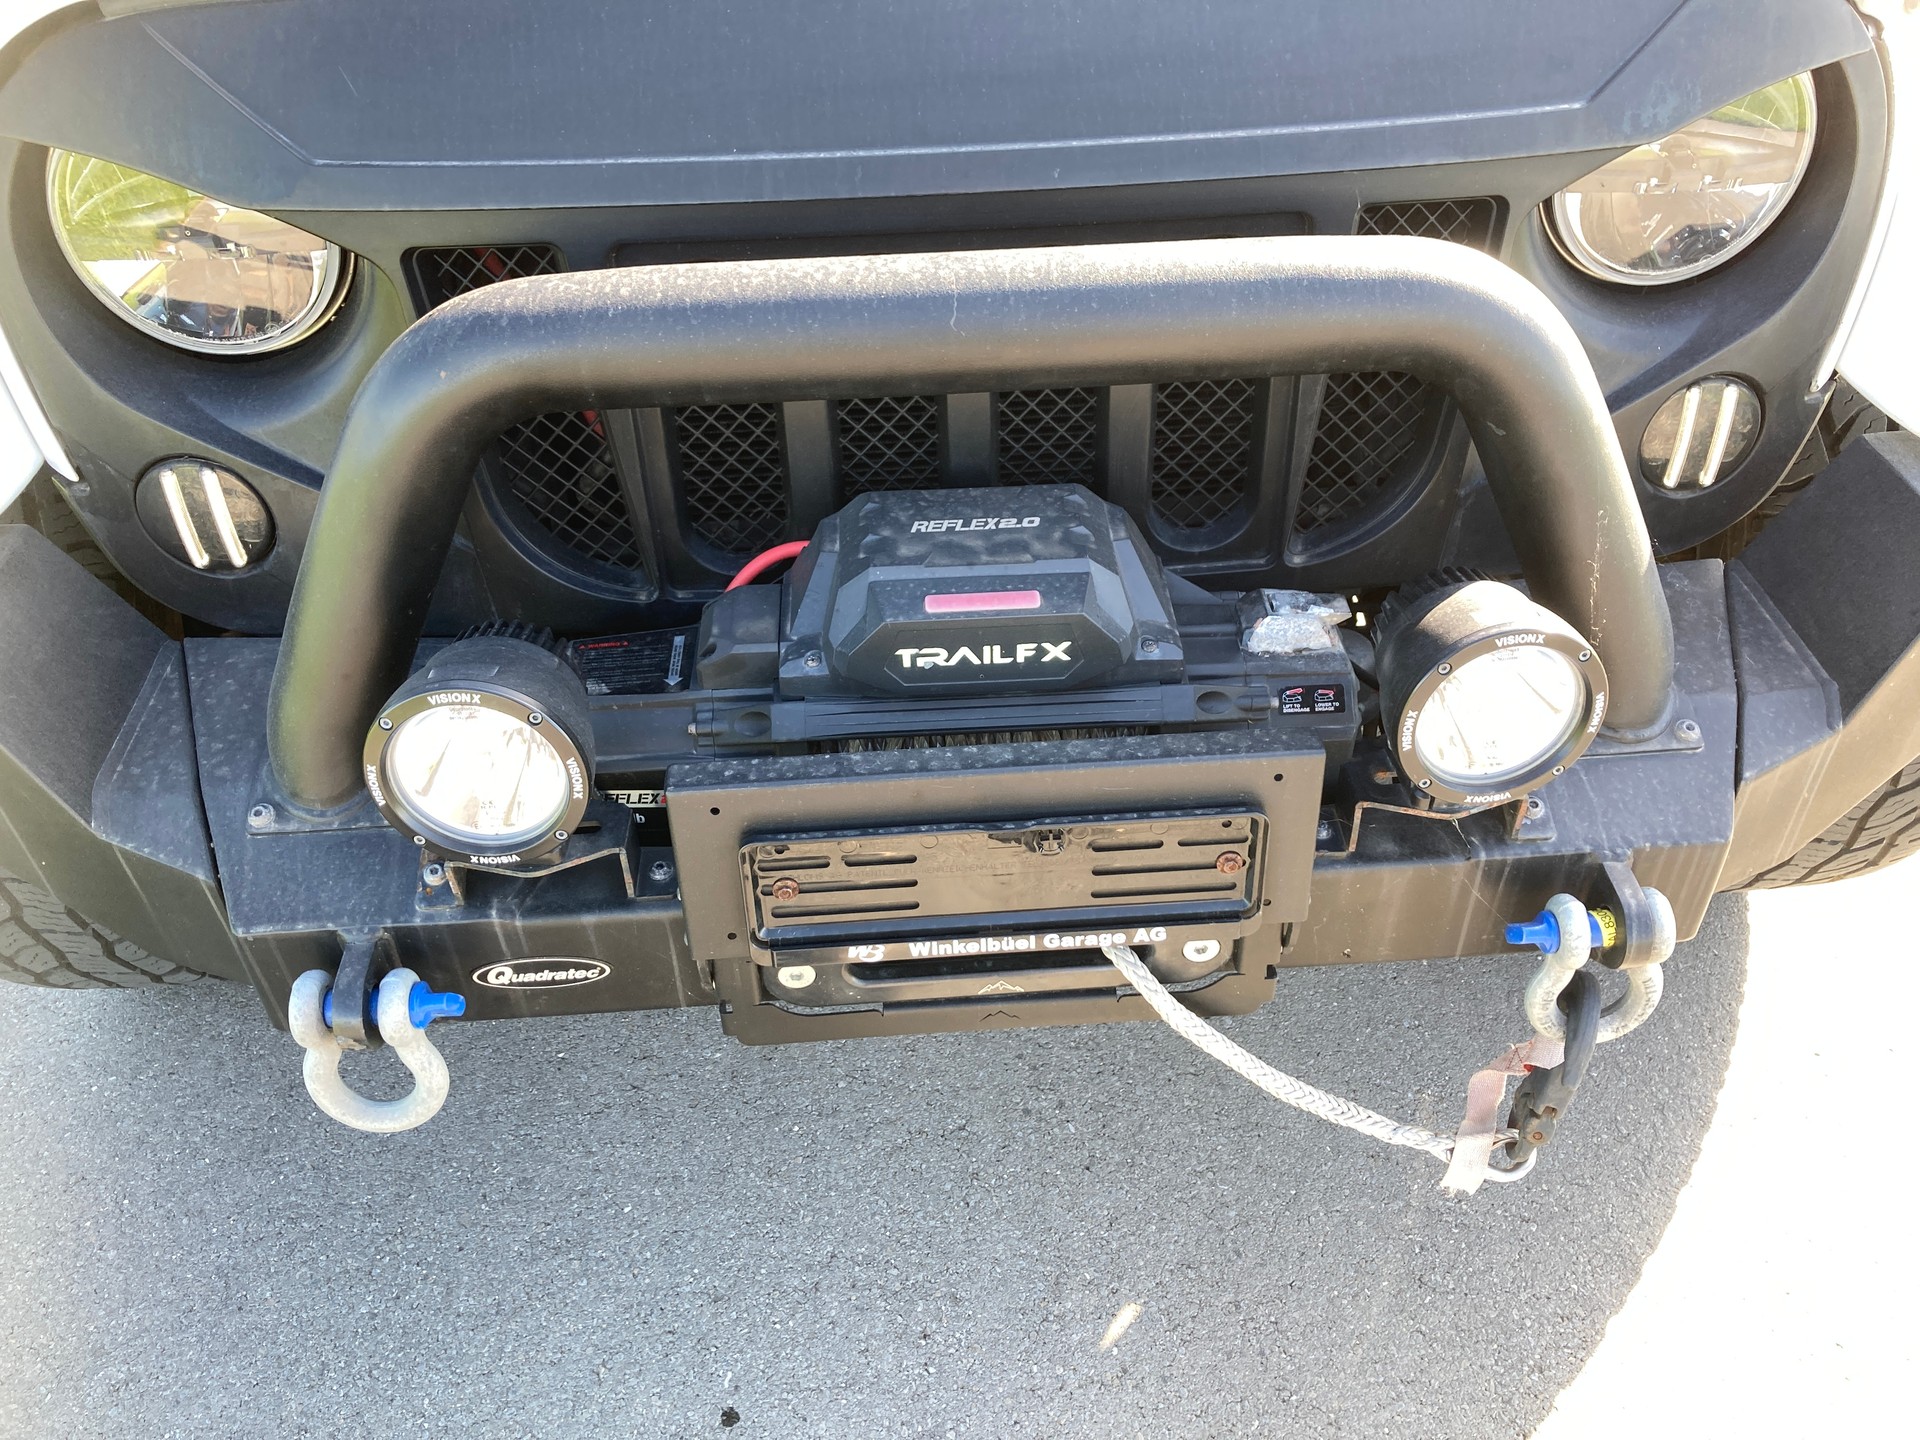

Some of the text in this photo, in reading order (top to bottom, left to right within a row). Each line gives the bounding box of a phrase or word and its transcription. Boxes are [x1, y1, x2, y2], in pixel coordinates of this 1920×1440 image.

[894, 641, 1072, 668] TRAILFX
[908, 934, 1036, 957] Winkelbüel
[1043, 932, 1127, 948] Garage
[1133, 927, 1167, 943] AG
[486, 966, 601, 985] Quadratec
